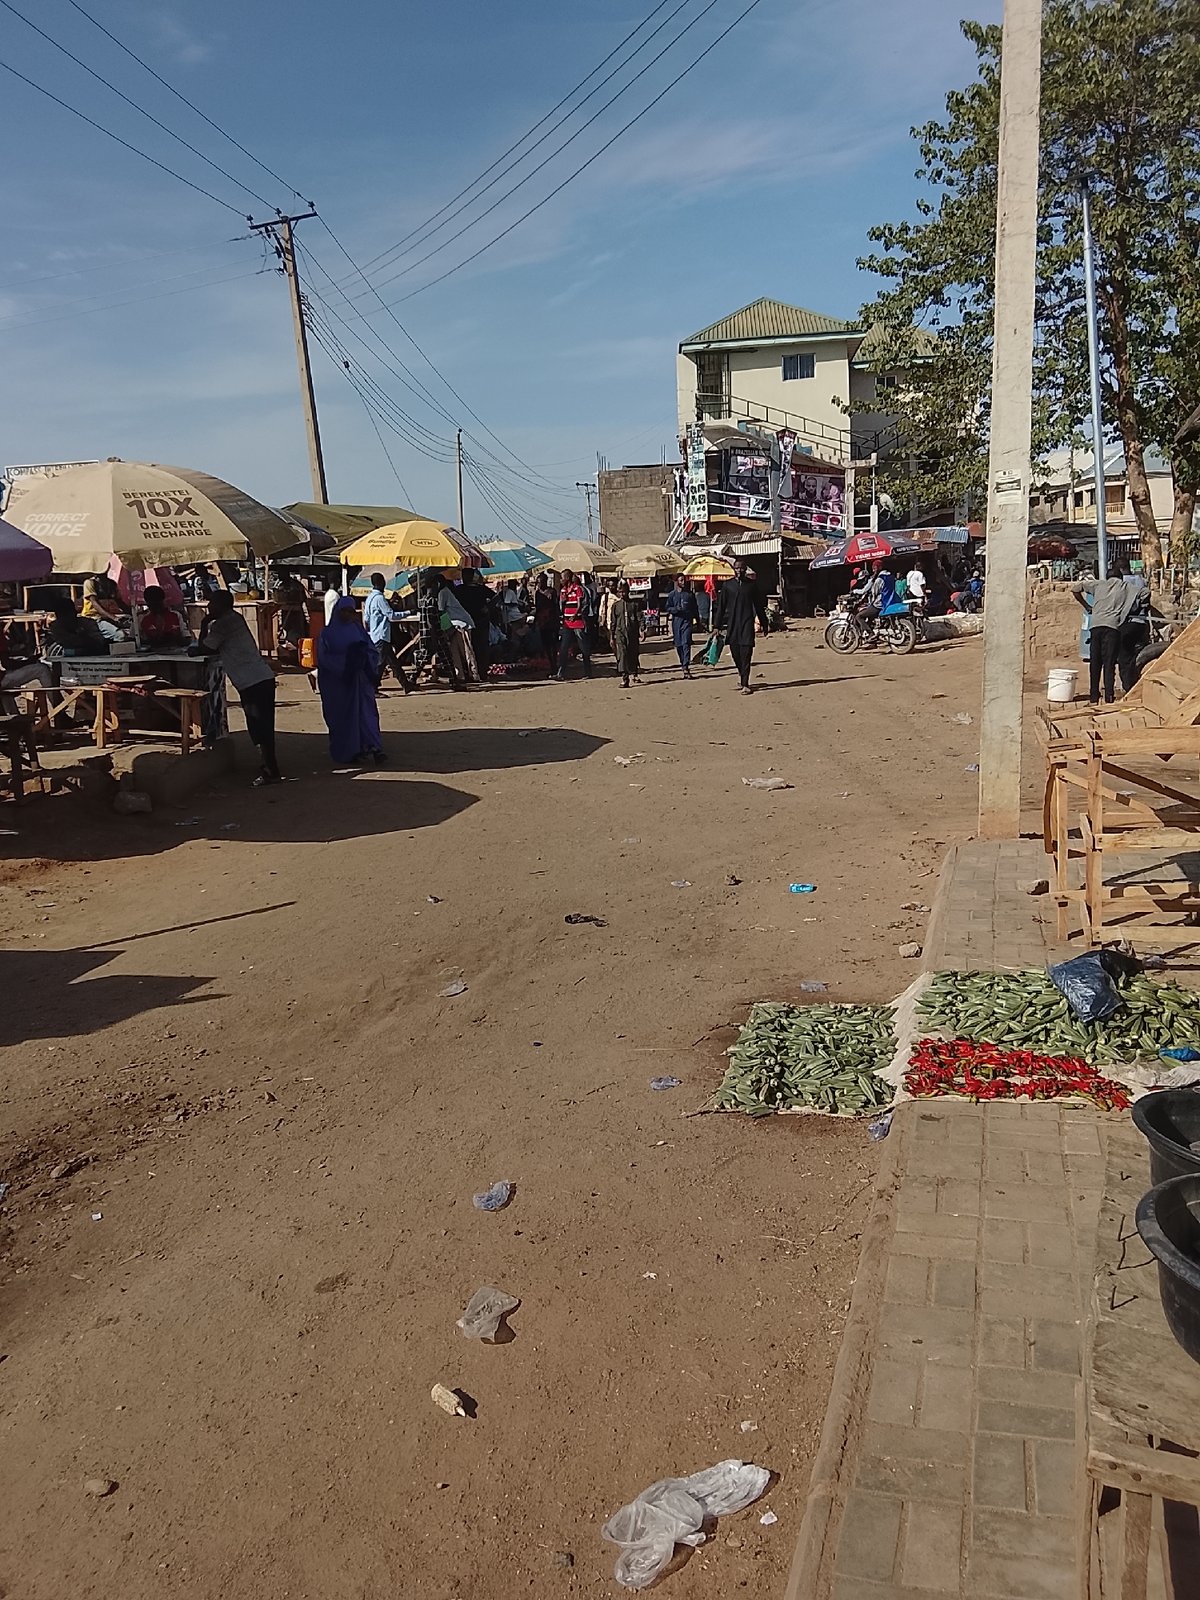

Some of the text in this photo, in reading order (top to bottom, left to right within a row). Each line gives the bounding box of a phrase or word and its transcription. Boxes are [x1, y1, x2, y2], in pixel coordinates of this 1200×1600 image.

[126, 497, 200, 519] 10X
[25, 512, 90, 522] CORRECT
[22, 523, 87, 536] VOICE
[140, 520, 204, 530] ON EVERY
[143, 529, 212, 539] RECHARGE
[655, 553, 676, 561] 10X
